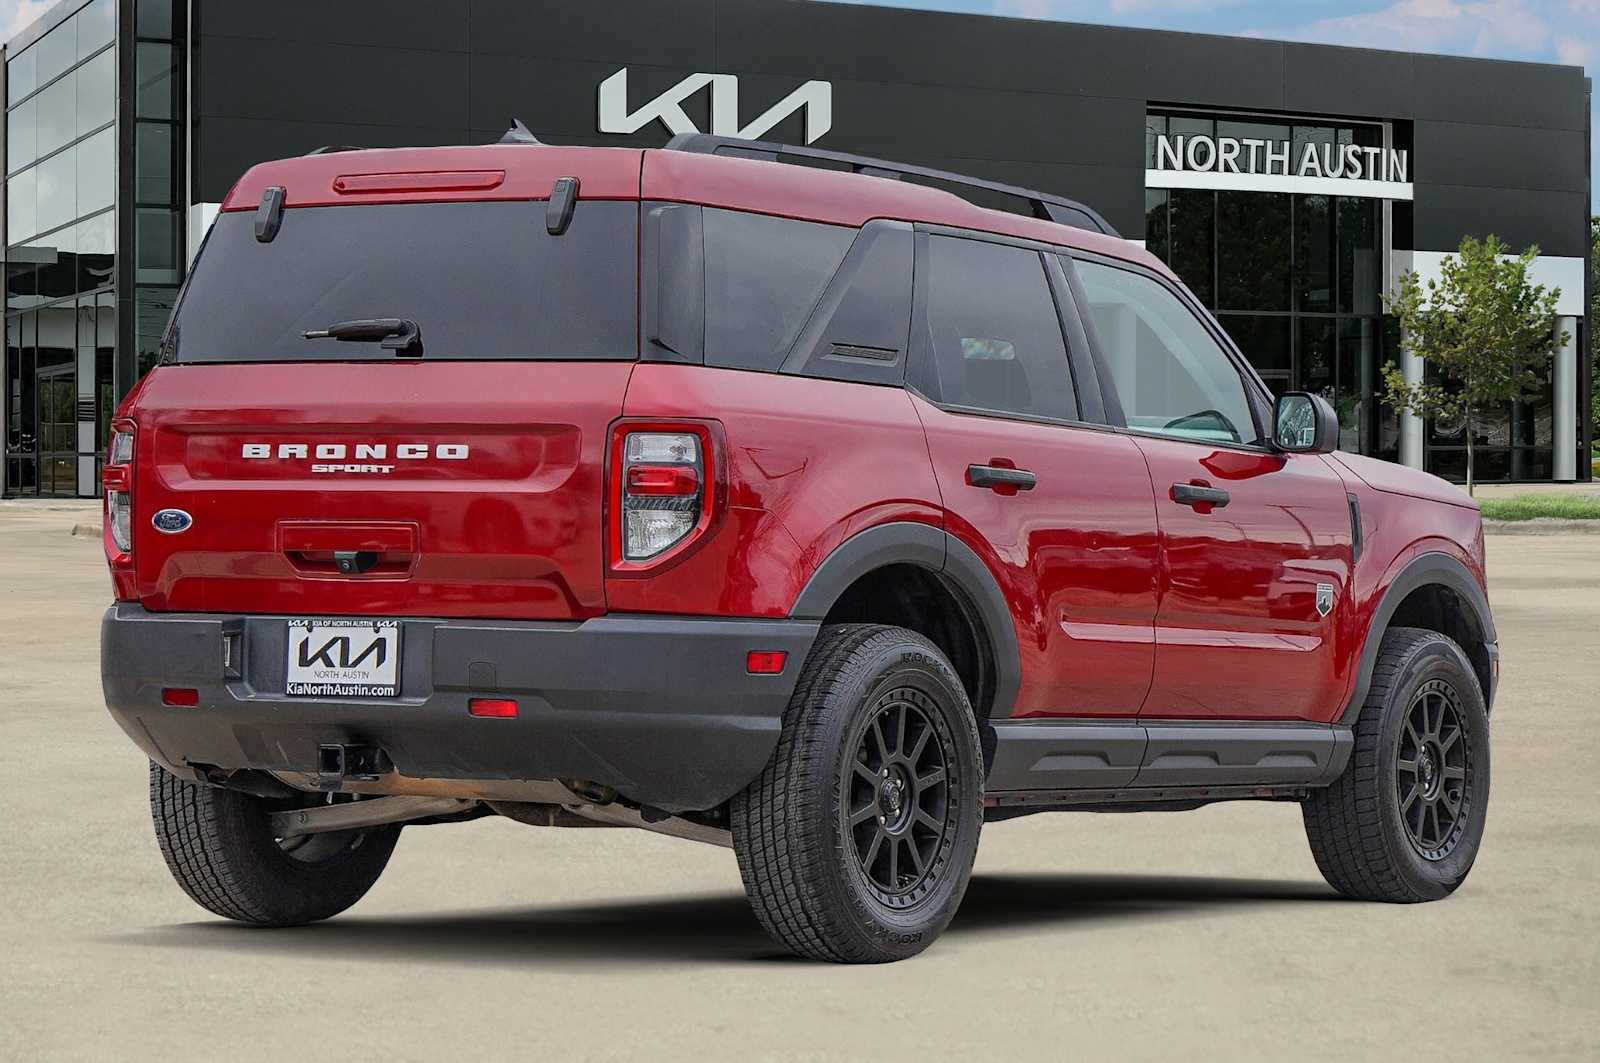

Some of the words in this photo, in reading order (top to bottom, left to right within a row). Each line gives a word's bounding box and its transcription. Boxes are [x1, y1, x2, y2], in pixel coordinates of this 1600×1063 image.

[599, 67, 832, 145] KIA
[1156, 134, 1291, 176] NORTH
[1298, 142, 1408, 183] AUSTIN
[242, 443, 469, 460] BRONCO
[311, 463, 395, 474] SPORT
[332, 620, 352, 628] NORTH
[352, 620, 374, 628] AUSTIN
[298, 636, 387, 669] KIA
[314, 671, 340, 679] NORTH
[343, 671, 370, 680] AUSTIN
[286, 683, 394, 696] KiaNorthAustin.com
